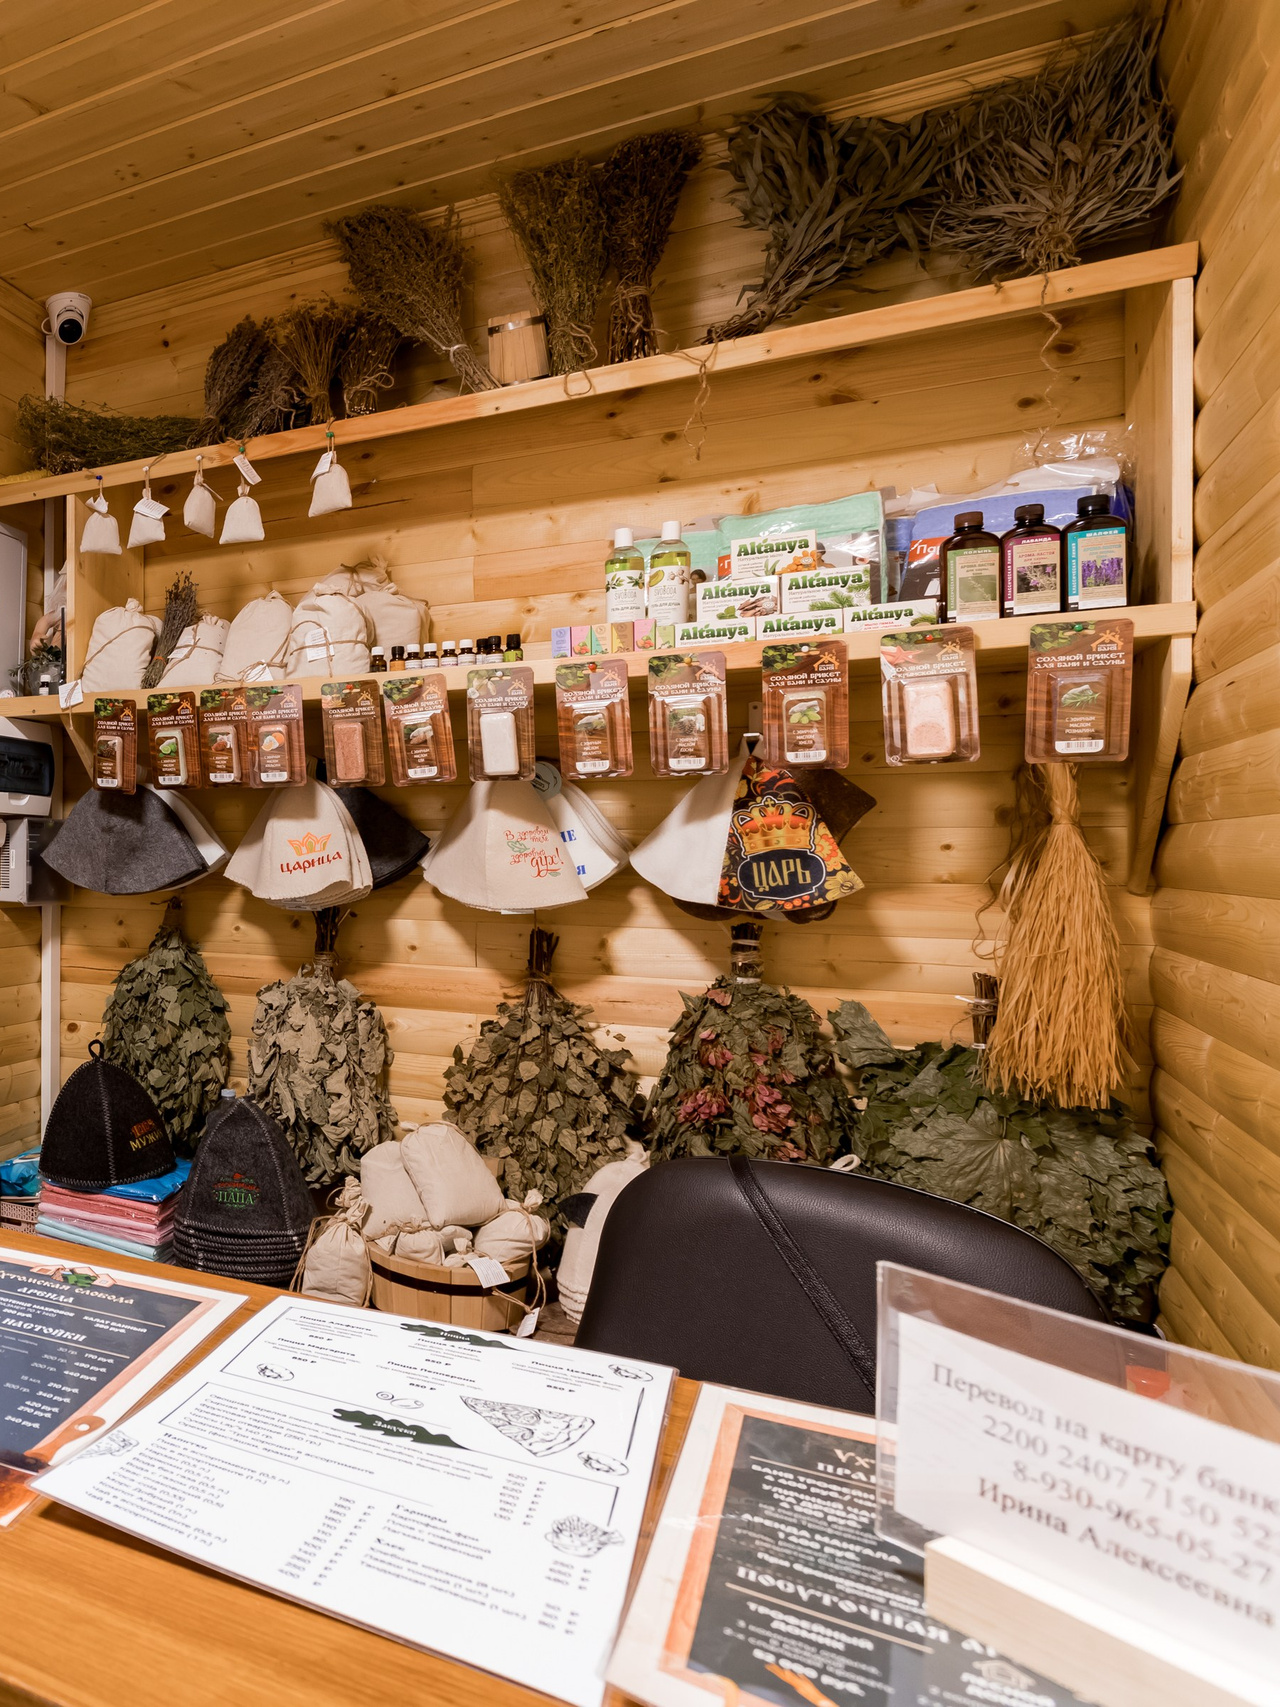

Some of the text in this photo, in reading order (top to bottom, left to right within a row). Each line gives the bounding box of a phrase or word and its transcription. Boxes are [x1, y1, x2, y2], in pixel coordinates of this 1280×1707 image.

[736, 538, 810, 557] Altanya
[788, 572, 863, 591] Altanya
[701, 582, 772, 601] Altanya
[850, 607, 914, 623] Altanya
[679, 624, 749, 641] Altanya
[762, 616, 837, 634] Altanya
[1036, 652, 1125, 663] СОЛЯНОЙ БРИКЕТ
[770, 671, 841, 682] СОЛЯНОЙ БРИКЕТ
[752, 858, 812, 892] ЦАРЬ
[218, 1190, 254, 1205] ПАПА
[2, 1316, 88, 1343] НАСТОЙКИ
[931, 1362, 1044, 1425] Перевод
[1055, 1414, 1089, 1441] на
[1099, 1430, 1186, 1481] карту
[982, 1414, 1049, 1458] 2200
[1057, 1444, 1129, 1488] 2407
[1232, 1516, 1280, 1550] 52
[978, 1476, 1068, 1536] Ирина
[1077, 1525, 1274, 1628] Алексеевна
